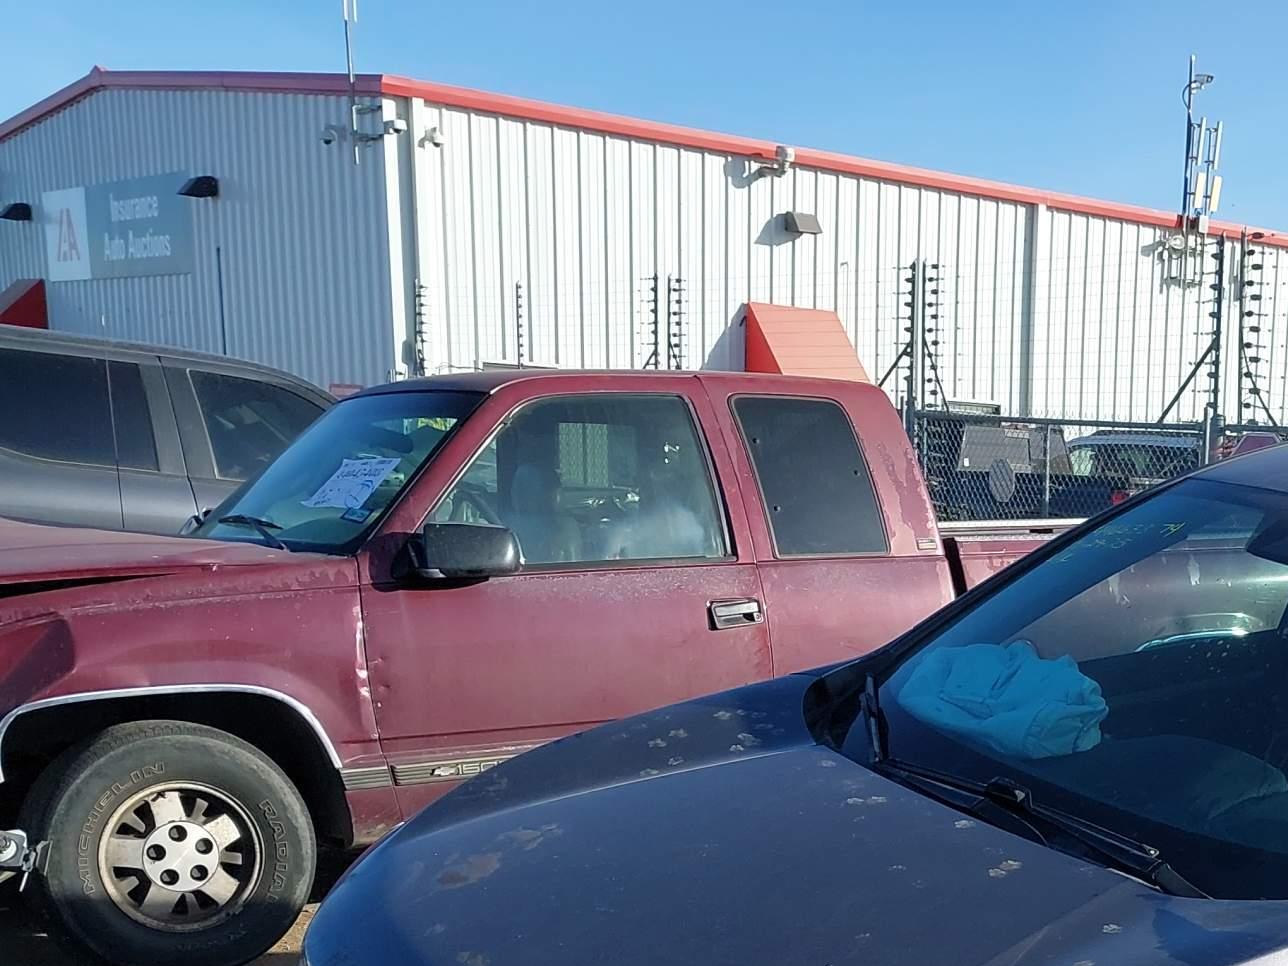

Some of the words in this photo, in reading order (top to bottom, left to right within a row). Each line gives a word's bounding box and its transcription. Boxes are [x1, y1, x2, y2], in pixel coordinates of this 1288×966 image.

[109, 192, 159, 222] Insurance
[103, 232, 126, 261] Auto
[128, 228, 172, 259] Auctions
[78, 760, 166, 896] MICHELIN
